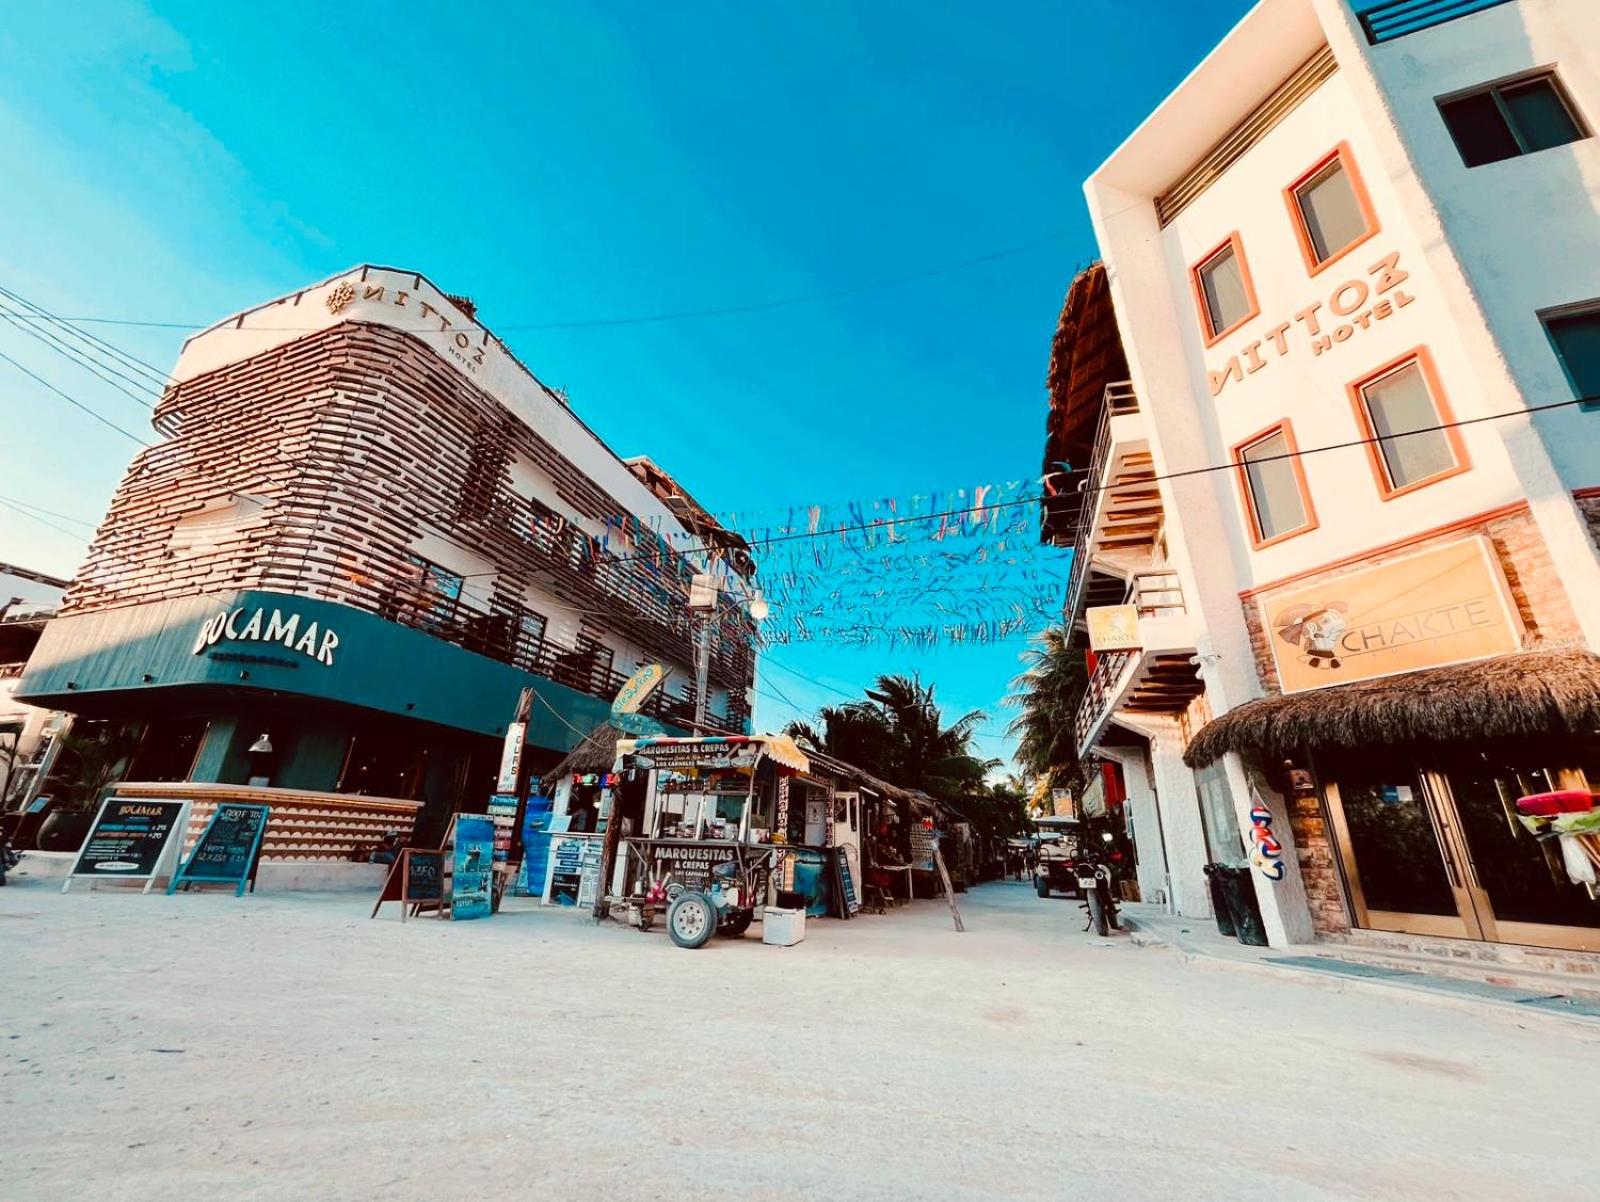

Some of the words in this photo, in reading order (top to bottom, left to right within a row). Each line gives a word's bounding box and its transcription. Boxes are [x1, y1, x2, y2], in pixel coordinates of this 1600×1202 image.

[1311, 291, 1415, 356] HOTEL
[449, 346, 477, 374] HOTEL
[1341, 600, 1490, 652] CHAKTE
[192, 607, 339, 667] BOCAMAR
[693, 744, 698, 753] &
[700, 743, 730, 753] CREPAS
[119, 805, 163, 816] BOCAMAR
[654, 847, 734, 861] MARQUESITAS
[682, 861, 709, 870] CREPAS
